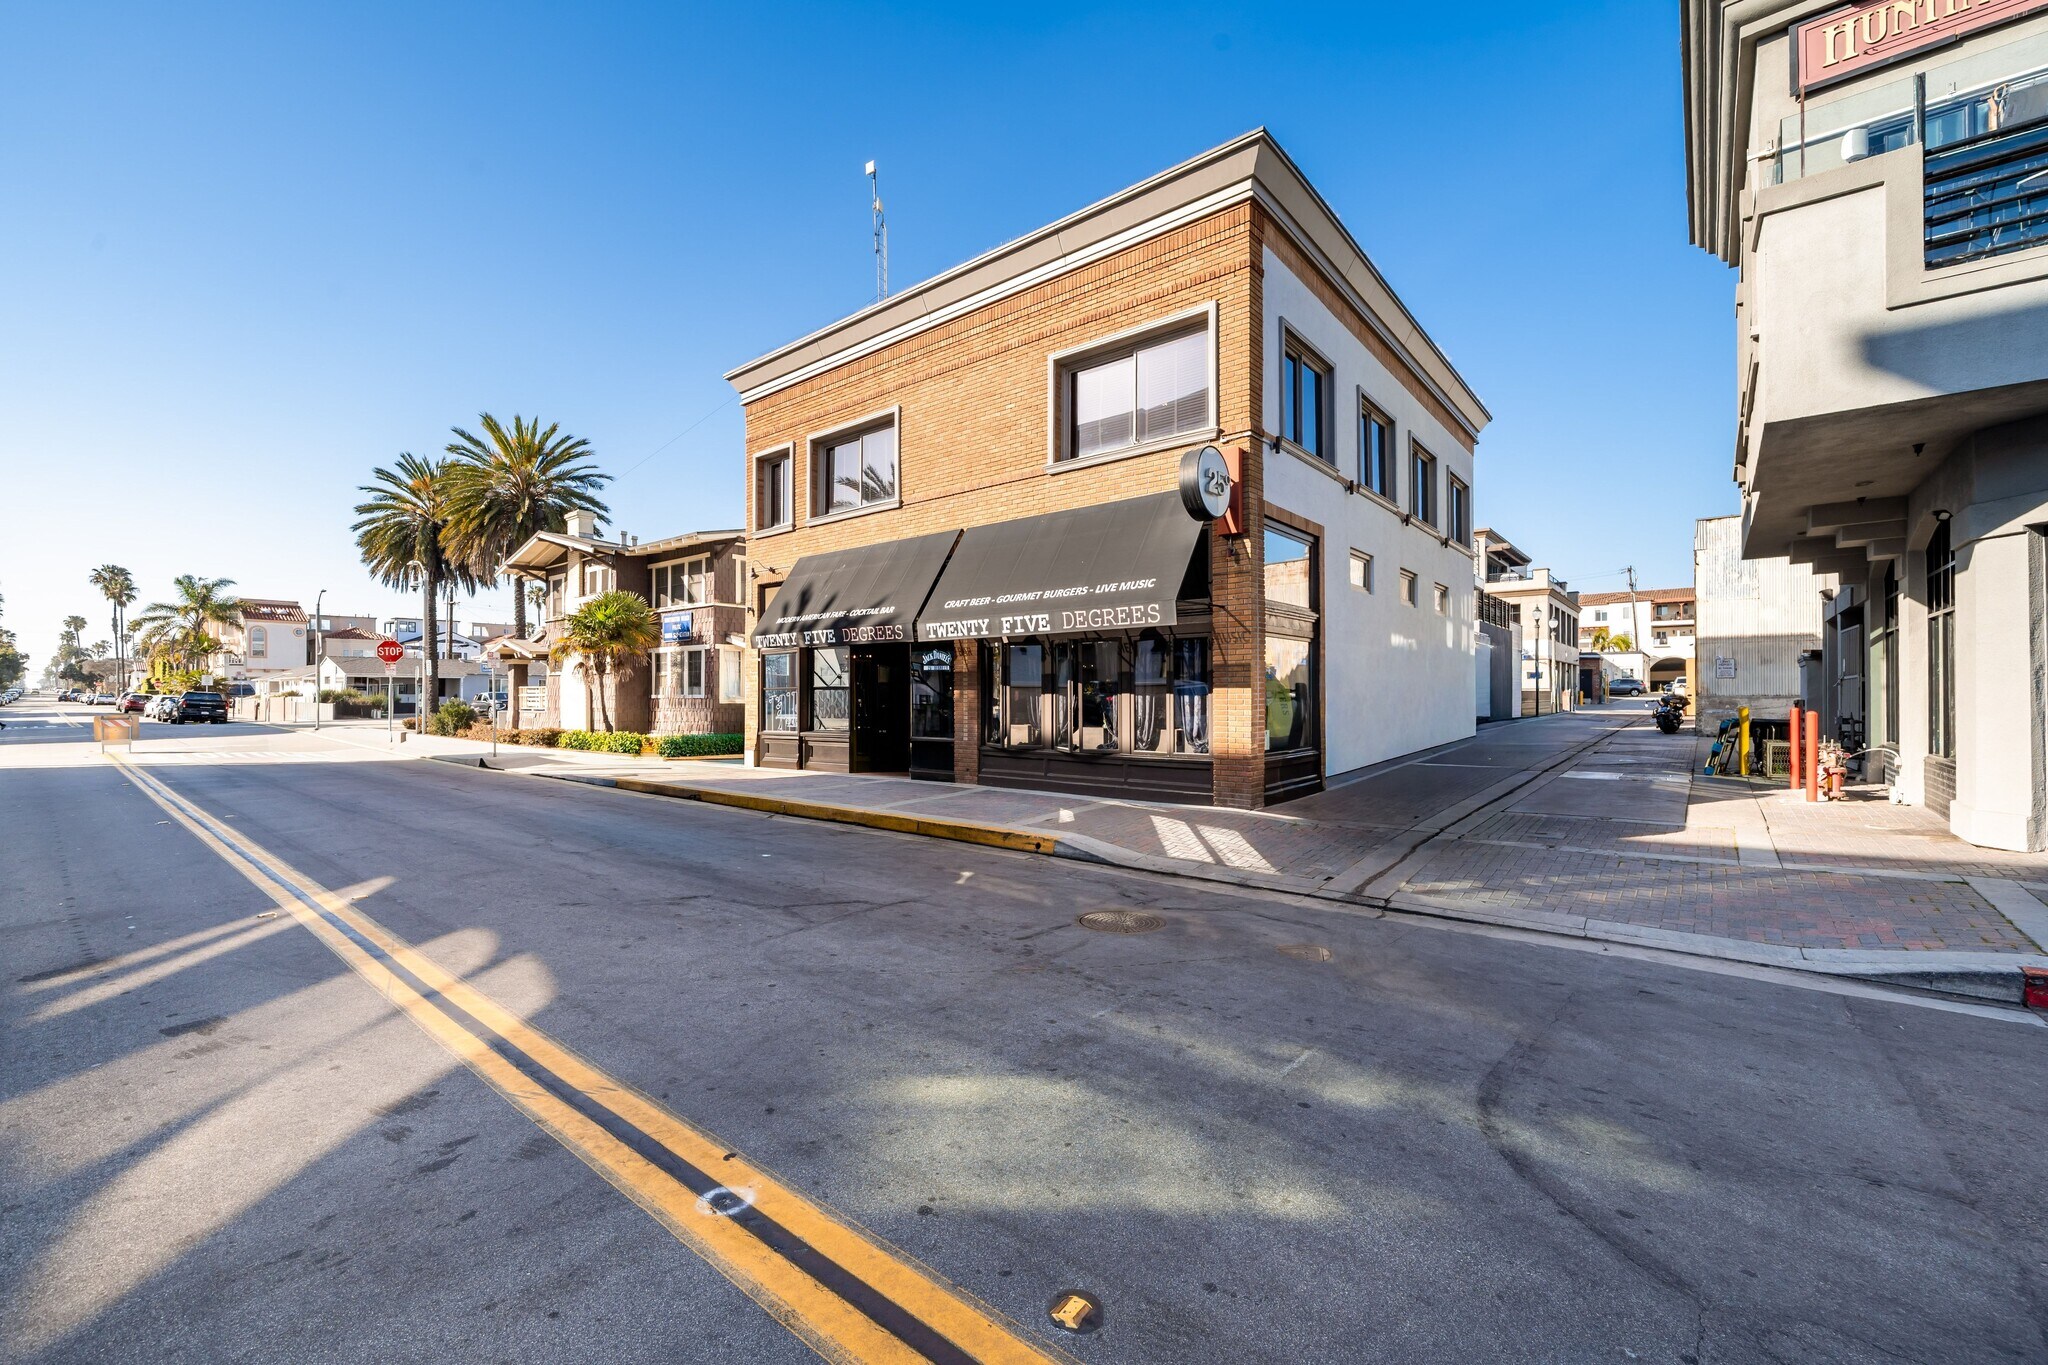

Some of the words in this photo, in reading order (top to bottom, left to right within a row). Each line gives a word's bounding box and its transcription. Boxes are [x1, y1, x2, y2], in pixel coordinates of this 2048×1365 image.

[1822, 0, 1990, 68] HUNT
[944, 599, 970, 609] CRAFT
[969, 597, 991, 607] BEER
[996, 591, 1043, 604] GOURMET
[1043, 586, 1089, 599] BURGERS
[1095, 582, 1119, 594] LIVE
[1119, 578, 1156, 591] MUSIC
[800, 612, 831, 621] AMERICAN
[849, 608, 880, 617] COCKTAIL
[879, 606, 896, 614] BAR
[925, 618, 990, 639] TWENTY
[1000, 613, 1051, 634] FIVE
[1061, 603, 1161, 630] DEGREES
[755, 632, 798, 648] TWENTY
[803, 629, 836, 645] FIVE
[841, 624, 904, 643] DEGREES
[377, 646, 403, 656] STOP
